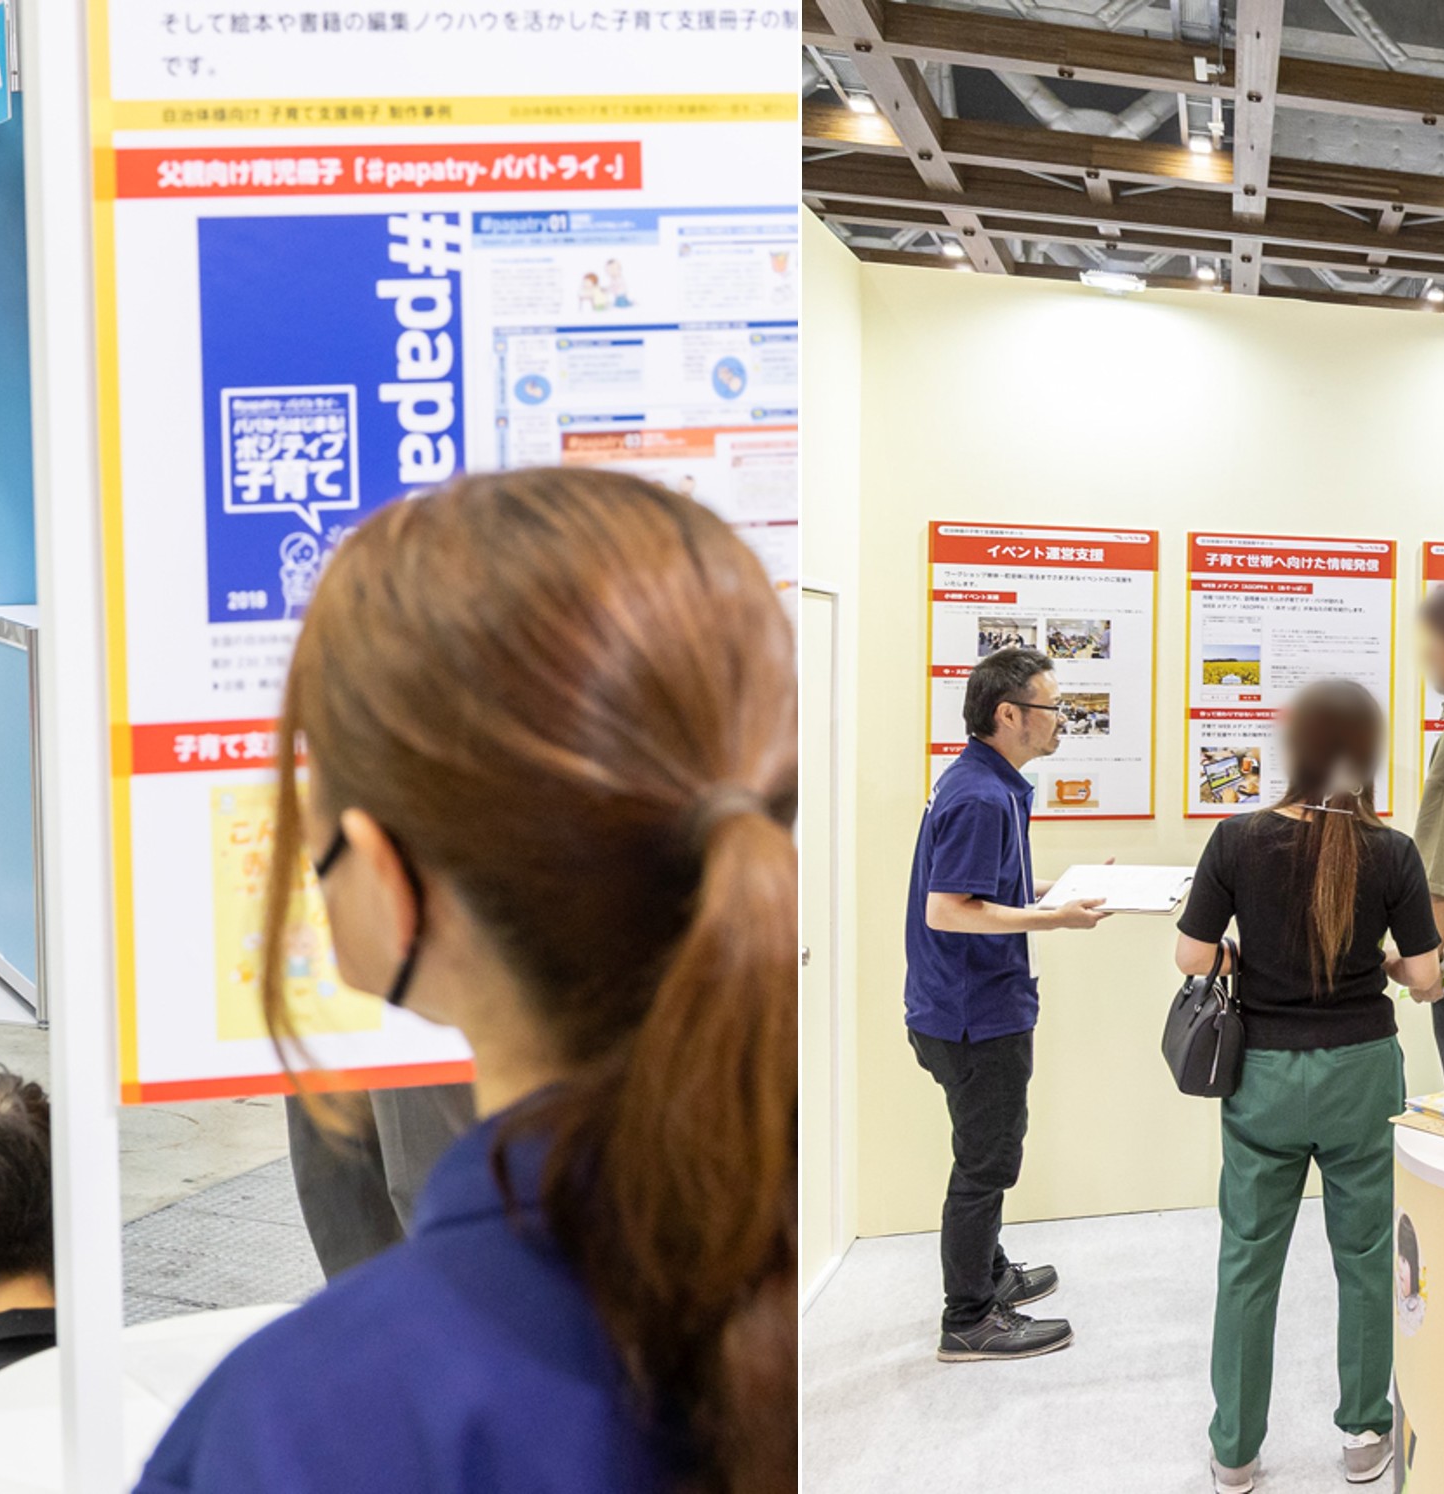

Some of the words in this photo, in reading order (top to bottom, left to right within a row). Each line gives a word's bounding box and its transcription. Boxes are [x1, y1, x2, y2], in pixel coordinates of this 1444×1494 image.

[162, 55, 217, 77] です。
[157, 158, 344, 187] 父親向け育児冊子
[233, 431, 348, 462] ポジティブ
[232, 458, 345, 503] 子育て
[986, 544, 1105, 563] イベント運営支援
[1205, 552, 1380, 572] 子育て世帯へ向けた情報発信
[173, 731, 279, 763] 子育て支
